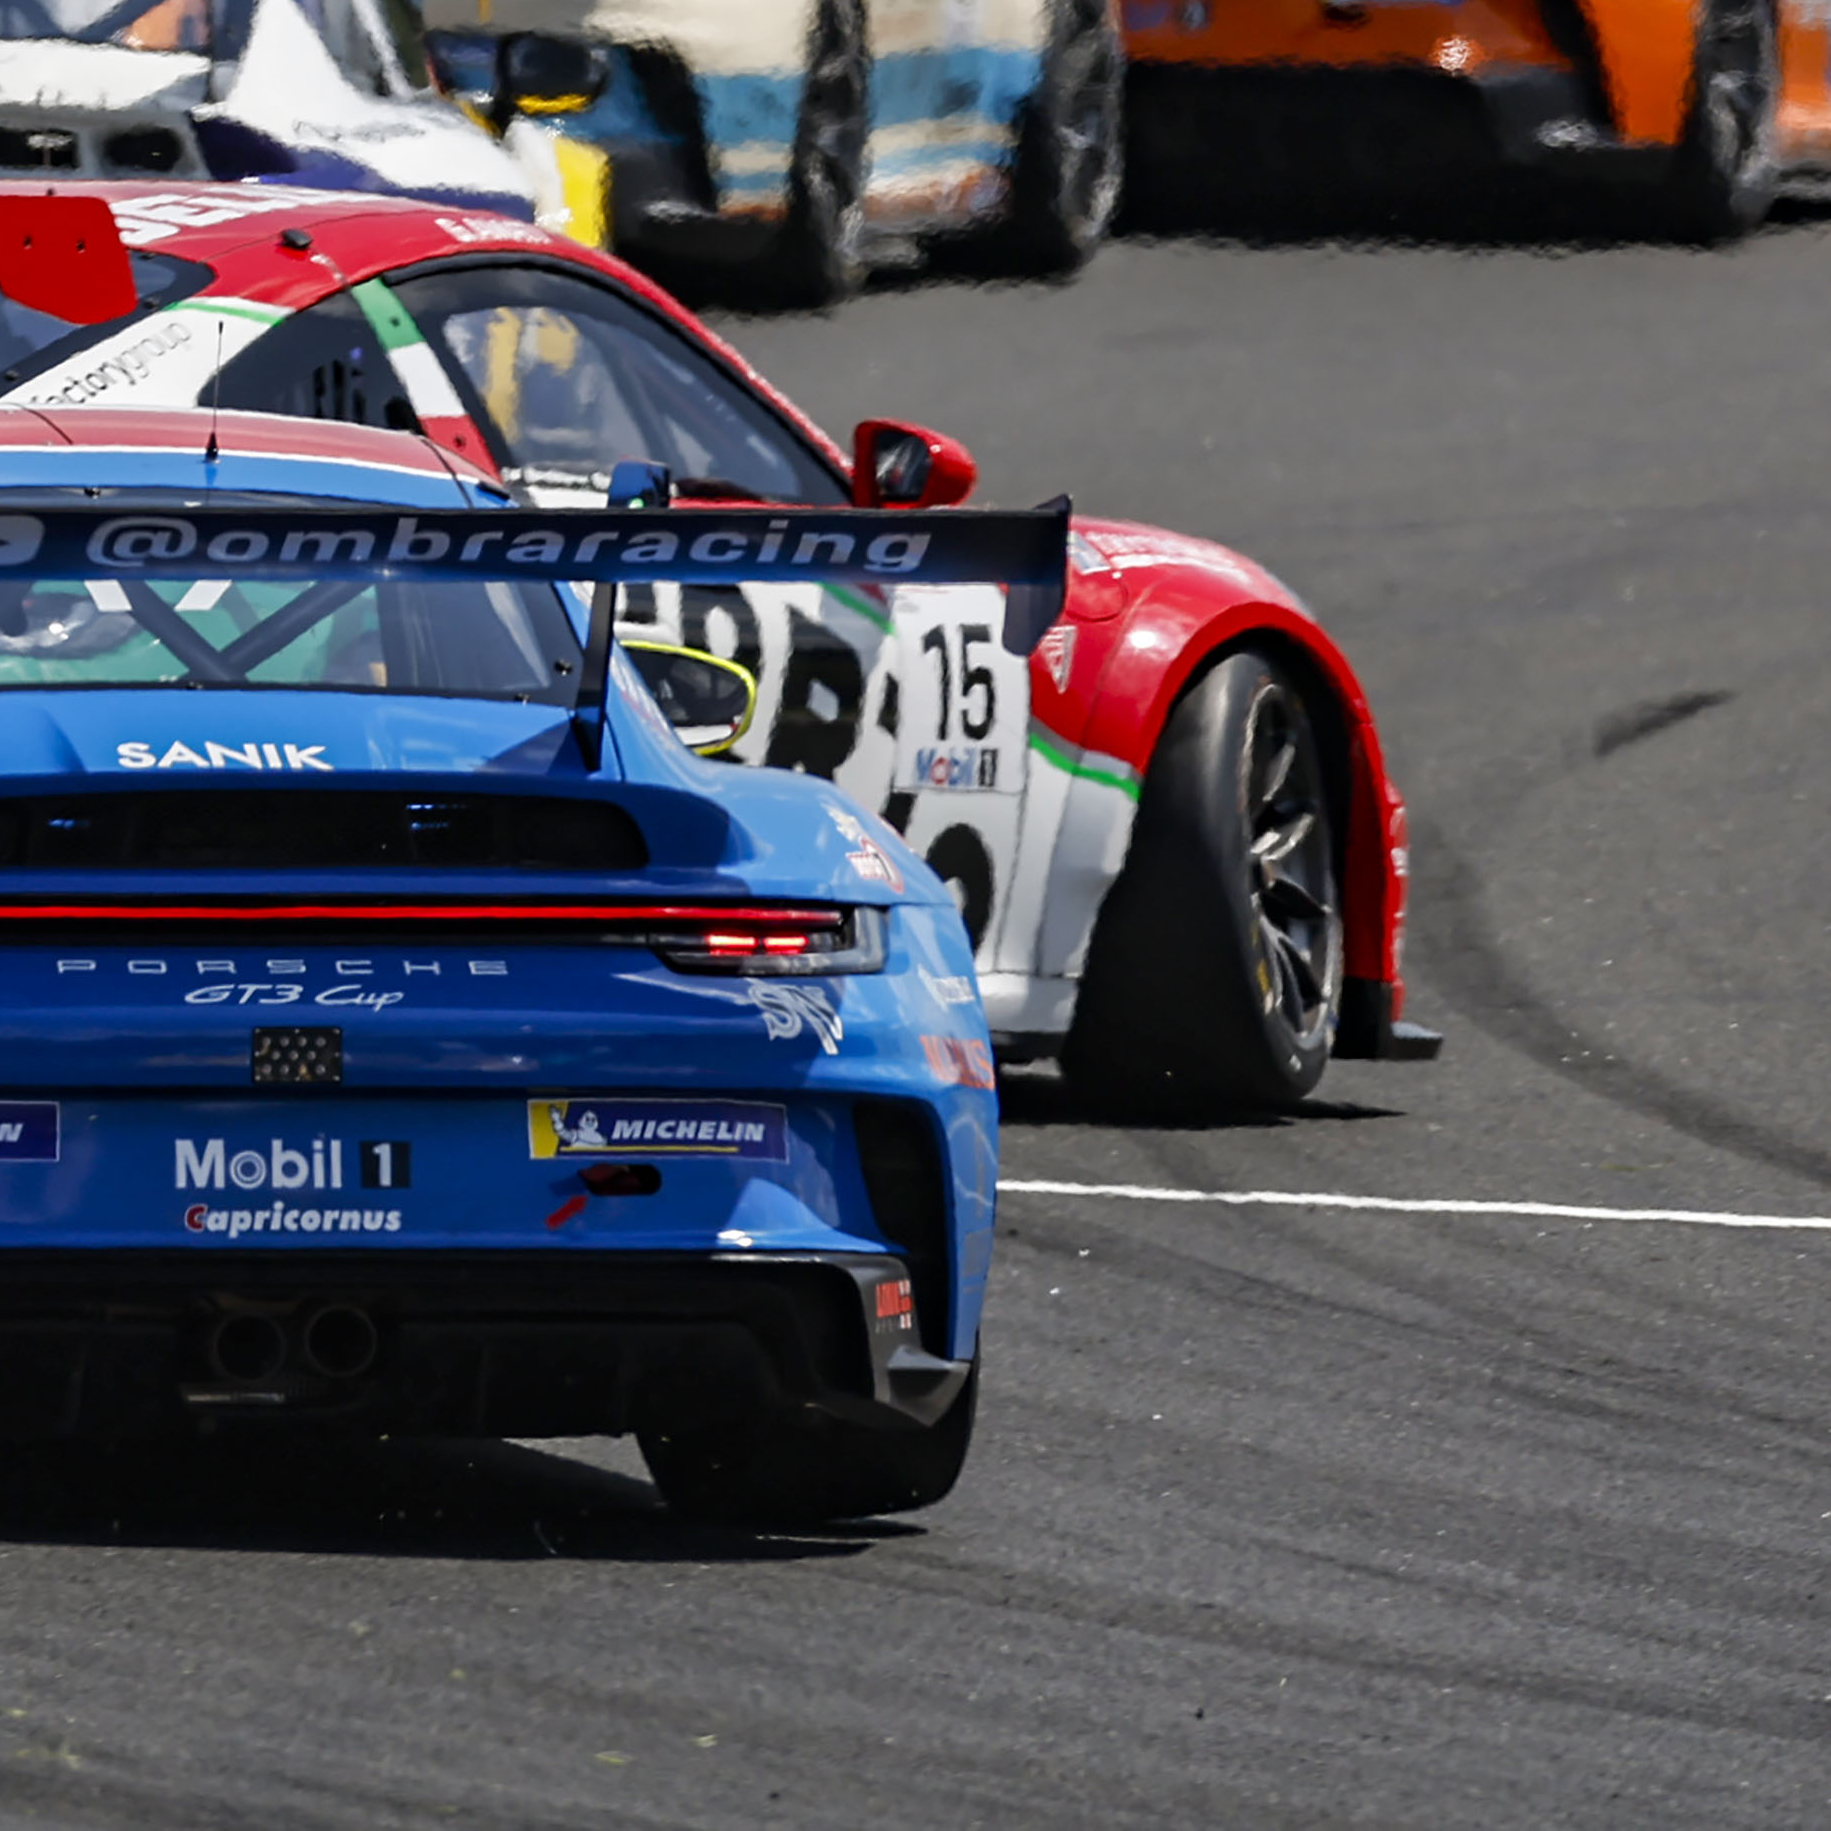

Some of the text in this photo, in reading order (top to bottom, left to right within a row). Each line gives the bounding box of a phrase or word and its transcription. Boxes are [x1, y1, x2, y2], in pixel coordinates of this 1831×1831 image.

[86, 516, 931, 572] @ombraracing
[921, 624, 996, 741] 15
[117, 741, 334, 771] SANIK
[56, 960, 509, 975] PORSCHE
[185, 984, 405, 1012] GT3 Cup
[612, 1118, 766, 1144] MICHELIN
[175, 1138, 395, 1190] Mobil 1
[185, 1203, 403, 1237] Capricornus
